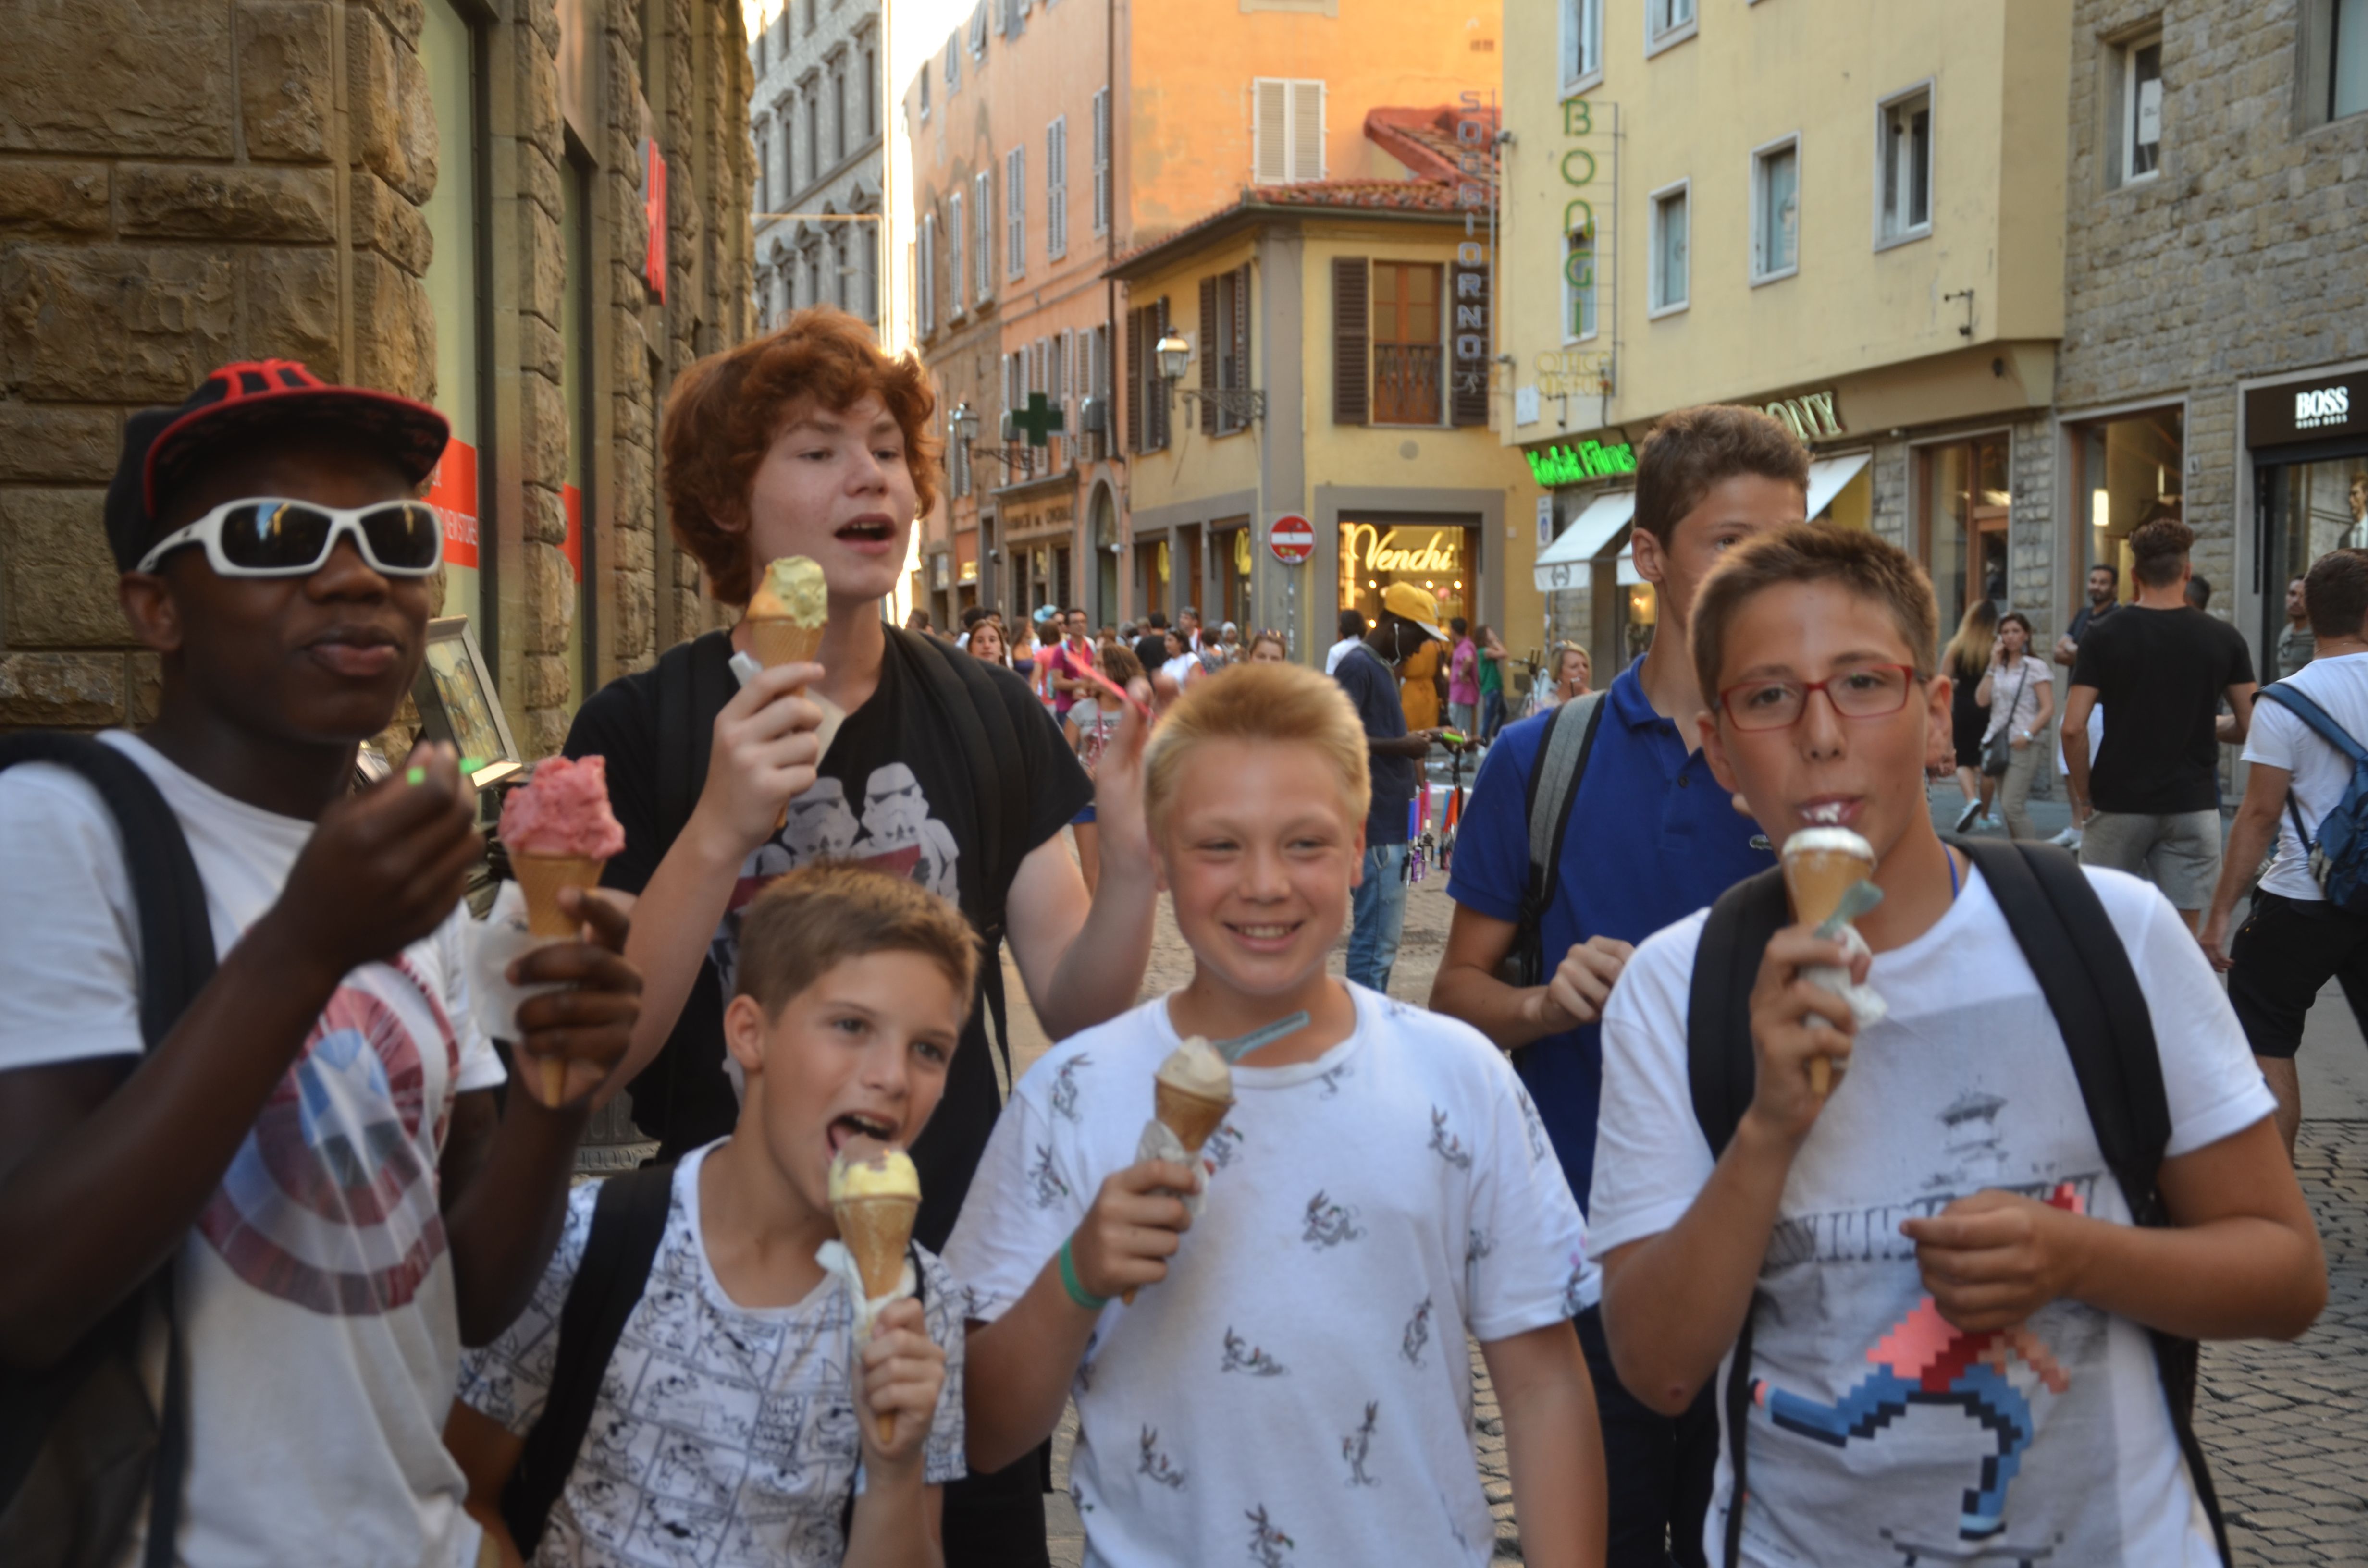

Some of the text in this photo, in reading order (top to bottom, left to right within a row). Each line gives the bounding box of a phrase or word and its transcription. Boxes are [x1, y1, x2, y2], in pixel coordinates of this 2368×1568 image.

[1457, 90, 1482, 360] SOGGIORNO
[1561, 98, 1597, 338] BONGI
[2295, 386, 2349, 420] BOSS
[1349, 523, 1455, 572] Venchi
